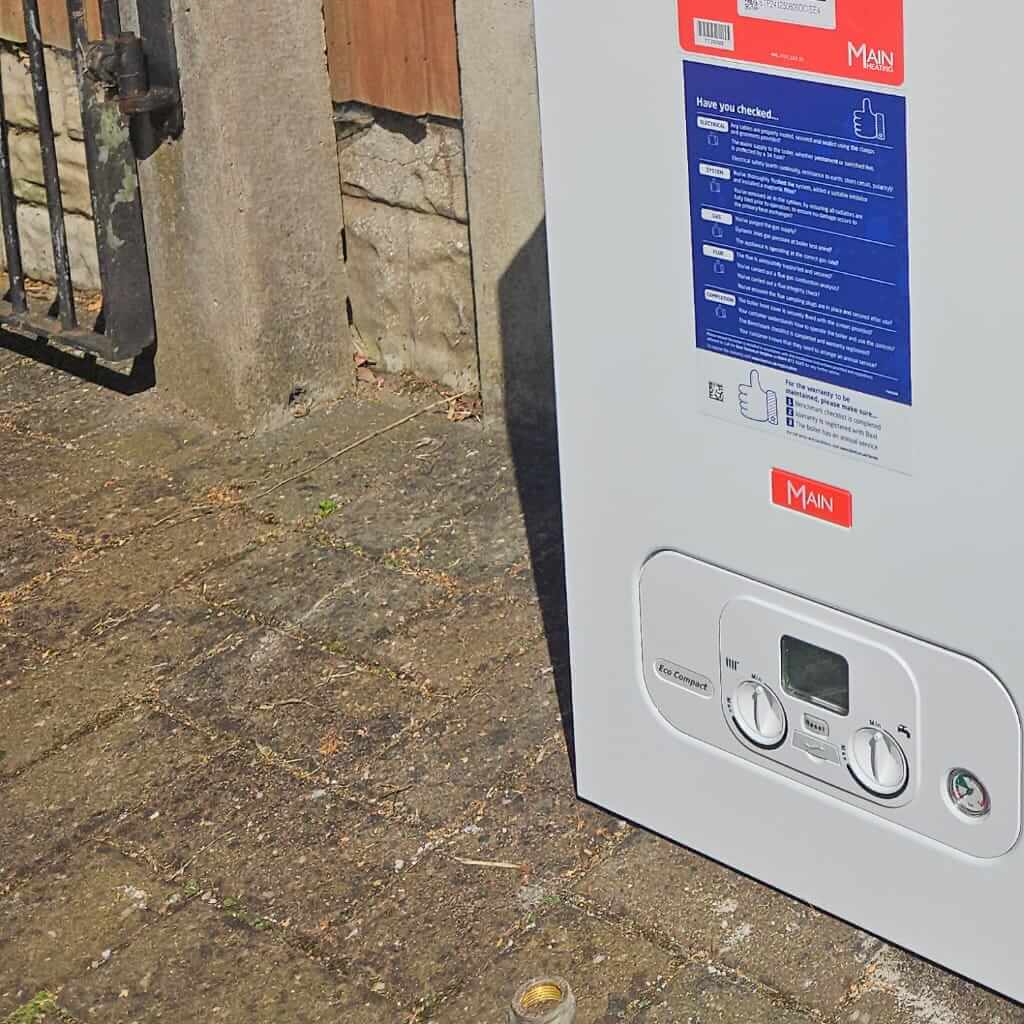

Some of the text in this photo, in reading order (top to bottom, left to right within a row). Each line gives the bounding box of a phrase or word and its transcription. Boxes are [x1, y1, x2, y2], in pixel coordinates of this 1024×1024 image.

[848, 41, 894, 69] MAIN
[696, 96, 718, 110] Have
[719, 102, 735, 114] you
[787, 480, 833, 513] MAIN
[659, 664, 707, 691] Eco Compact
